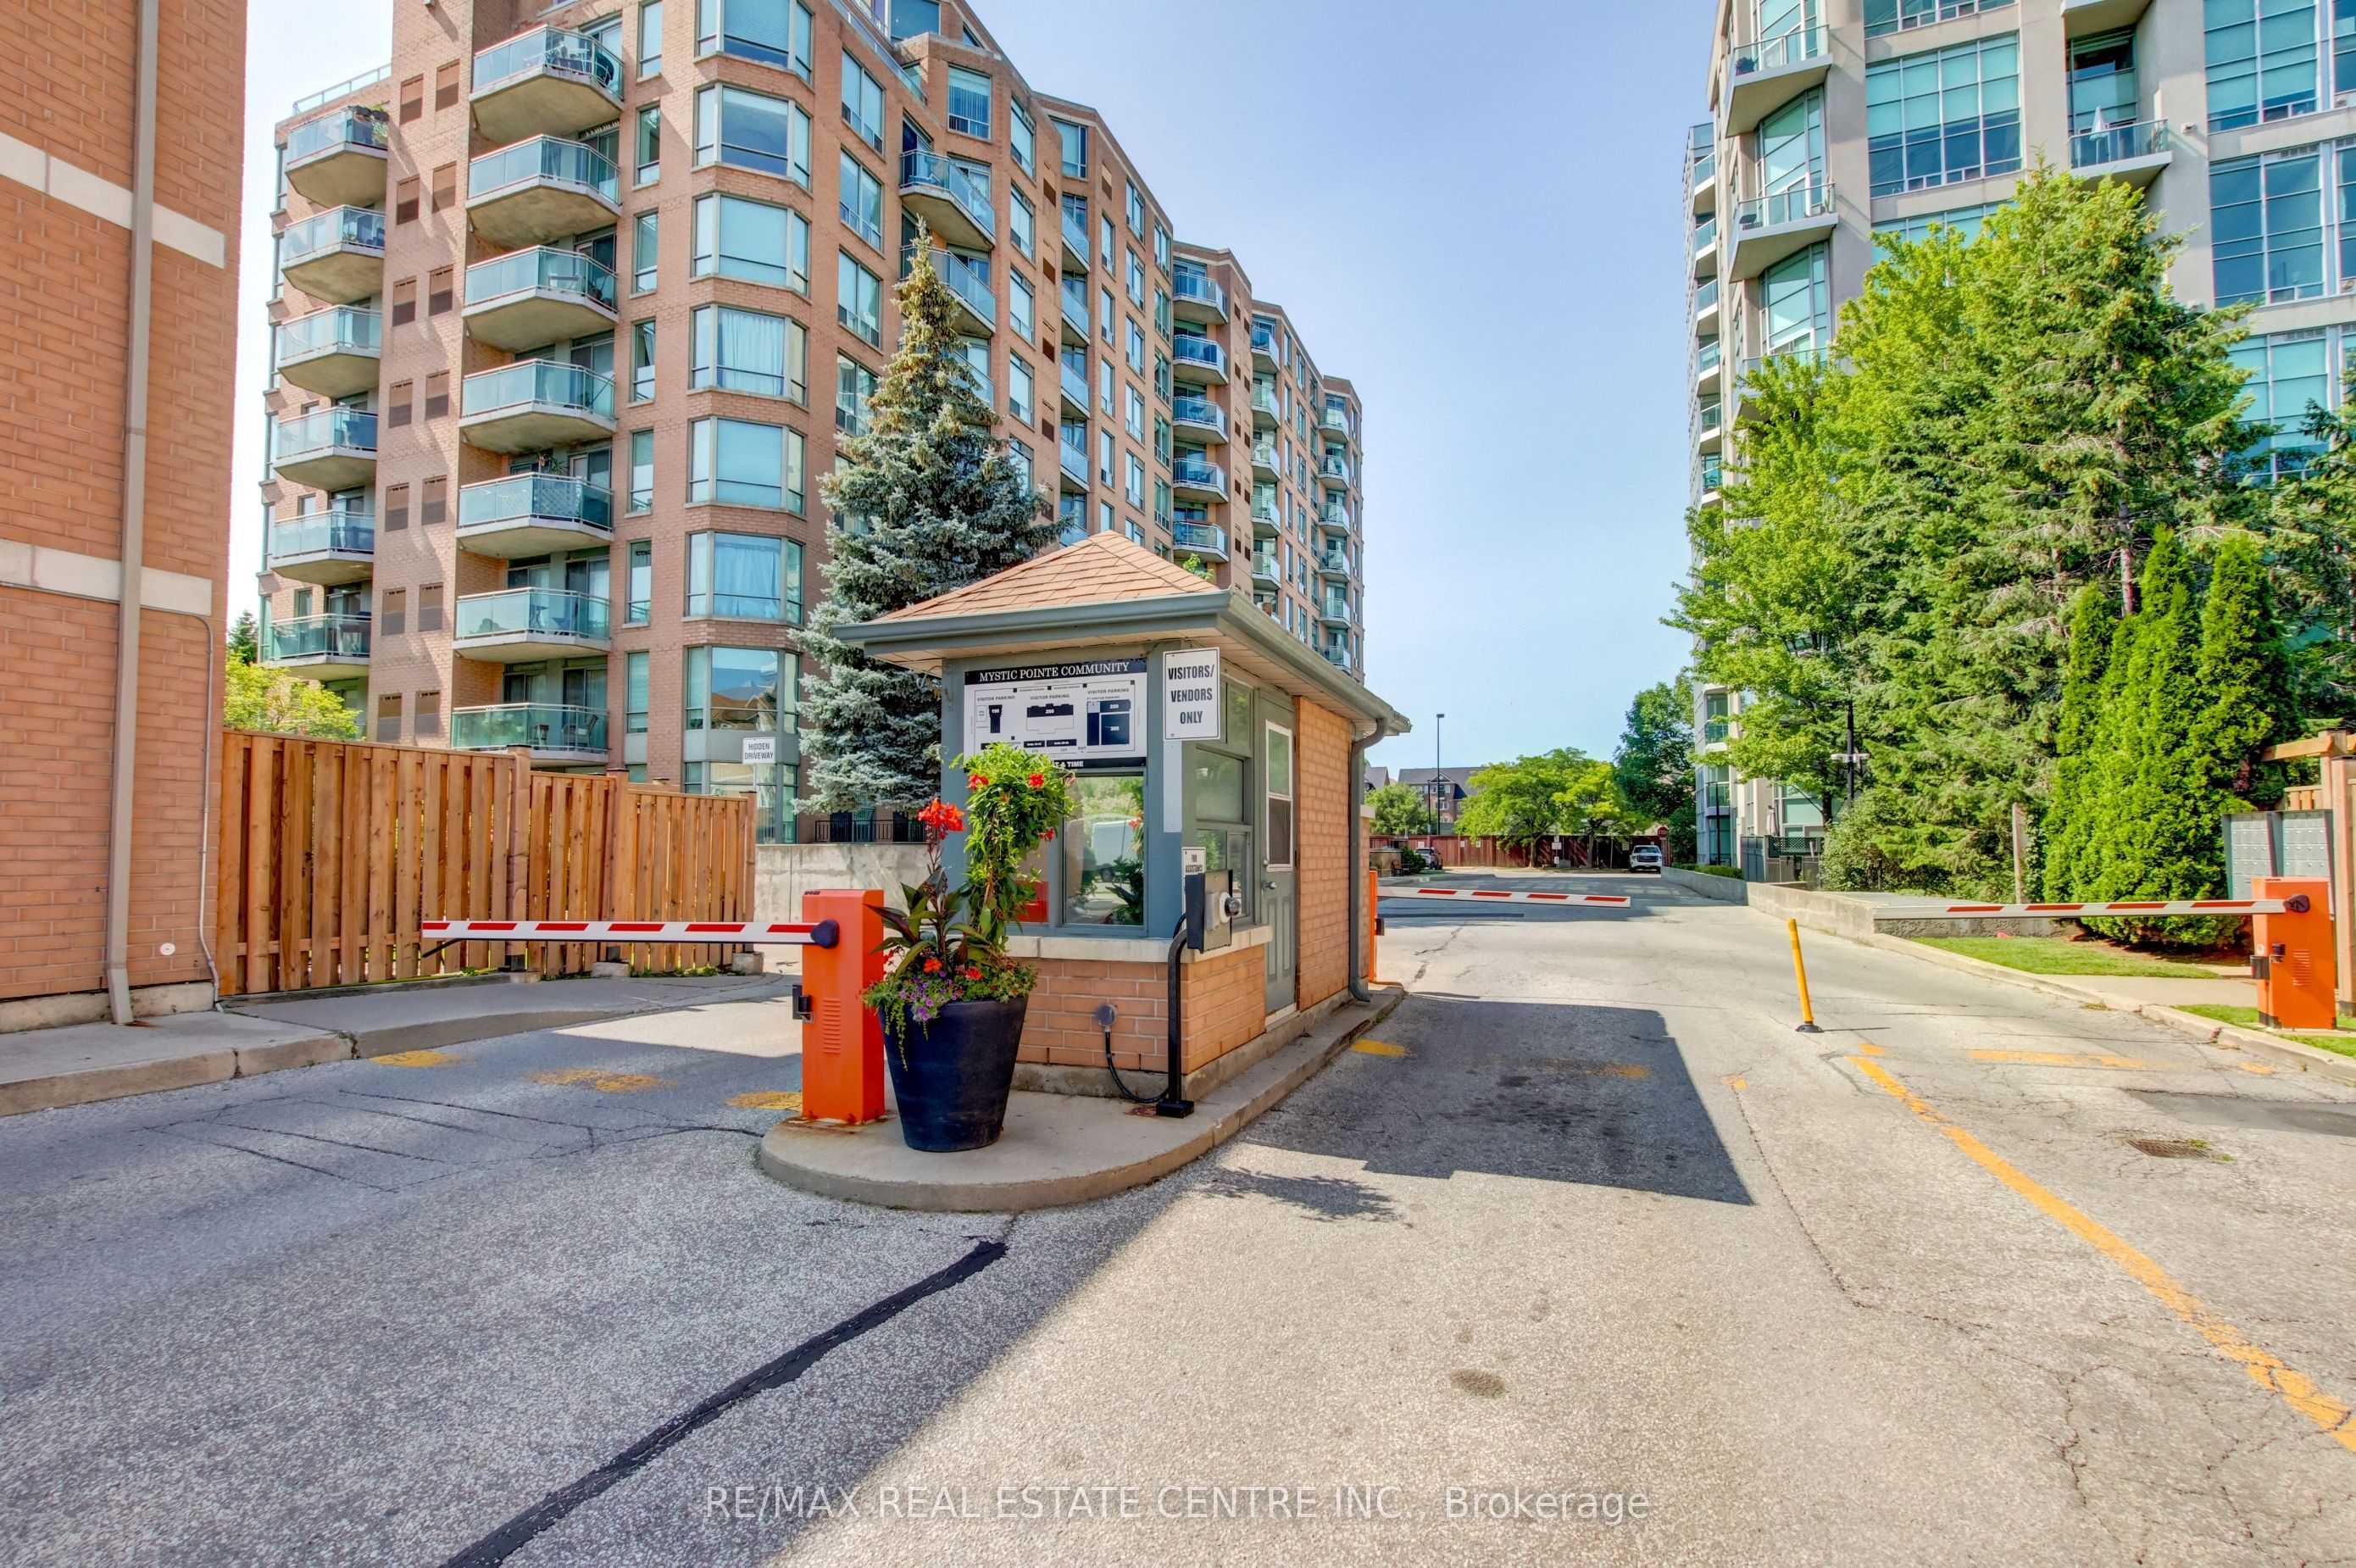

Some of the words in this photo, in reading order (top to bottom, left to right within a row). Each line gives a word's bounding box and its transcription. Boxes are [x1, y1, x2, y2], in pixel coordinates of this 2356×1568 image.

[980, 670, 1017, 681] MYSTIC
[1020, 667, 1059, 678] POINTE
[1061, 661, 1130, 676] COMMUNITY
[1168, 664, 1214, 680] VISITORS/
[1170, 687, 1213, 703] VENDORS
[1180, 710, 1203, 725] ONLY
